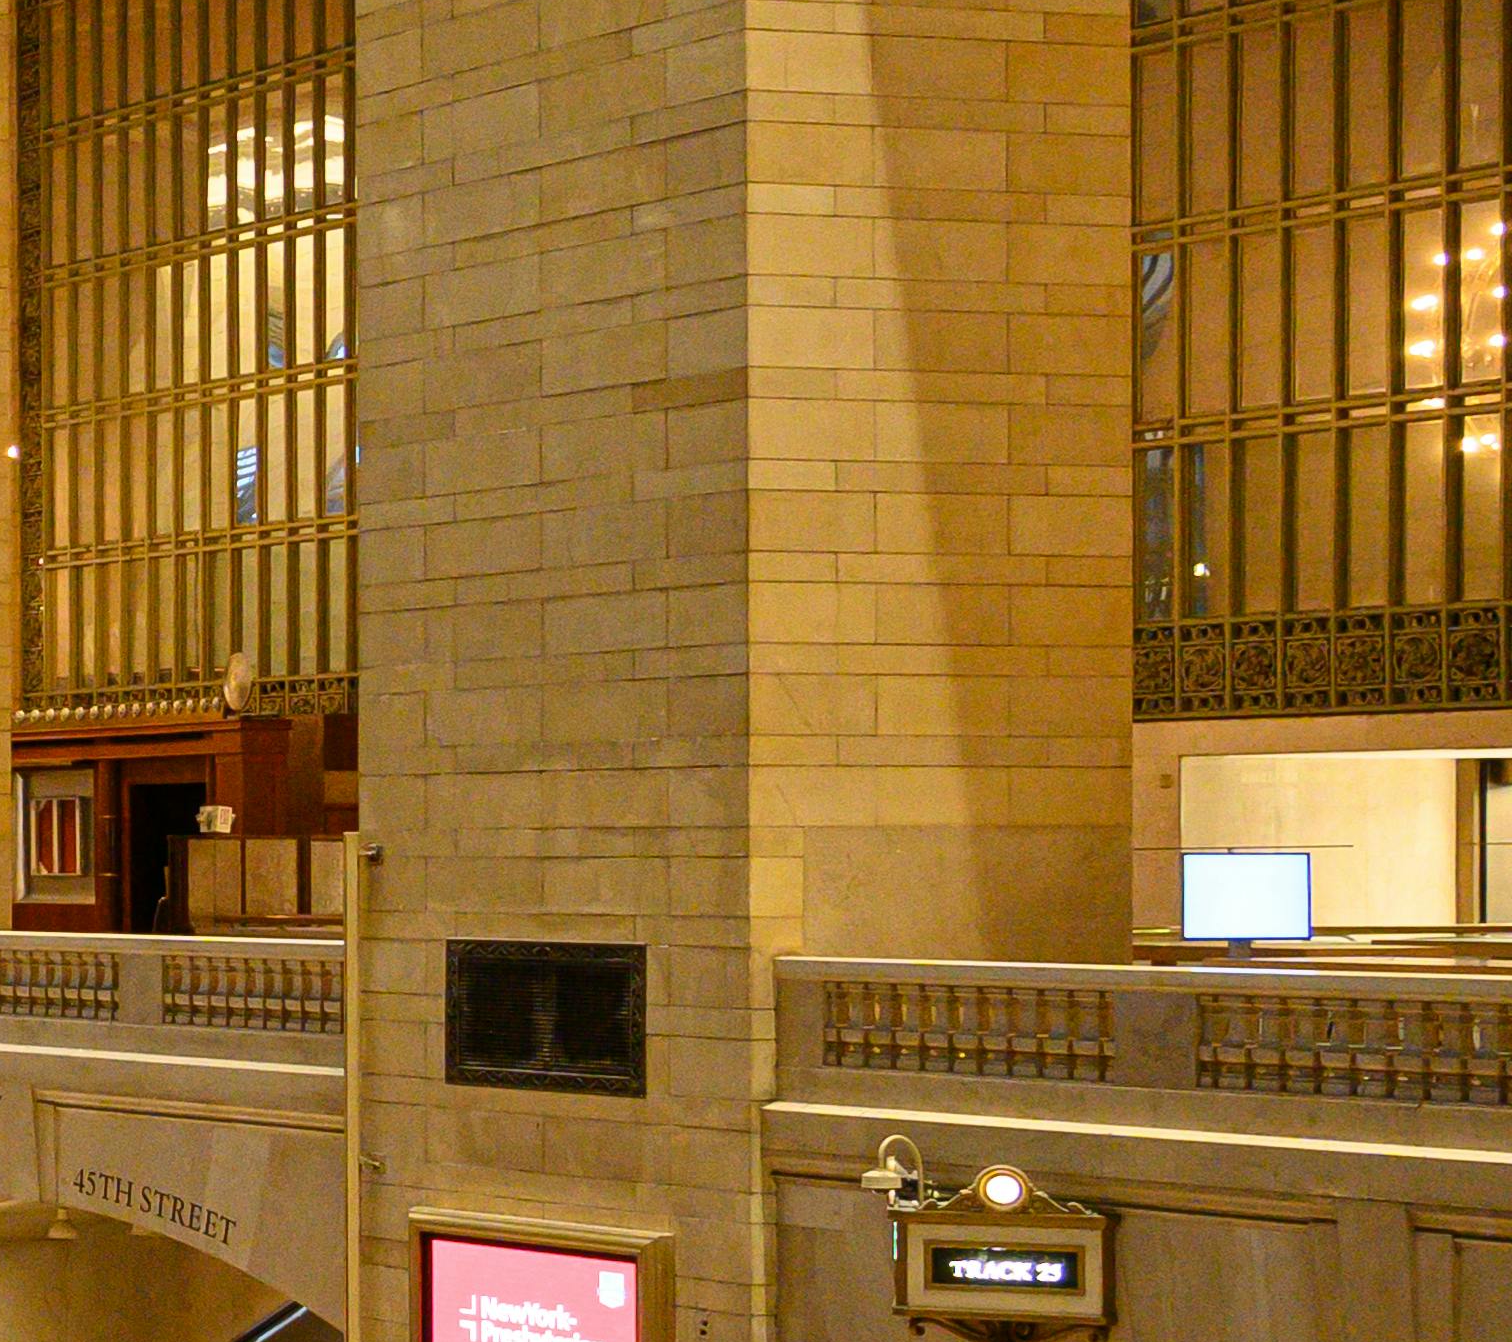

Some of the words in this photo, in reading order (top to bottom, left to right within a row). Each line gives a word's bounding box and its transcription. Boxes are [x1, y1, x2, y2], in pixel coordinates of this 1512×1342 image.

[73, 1168, 134, 1208] 45TH
[140, 1186, 237, 1245] STREET
[948, 1260, 1033, 1281] TRACK
[1035, 1262, 1064, 1283] 25
[480, 1295, 578, 1331] NewYork-
